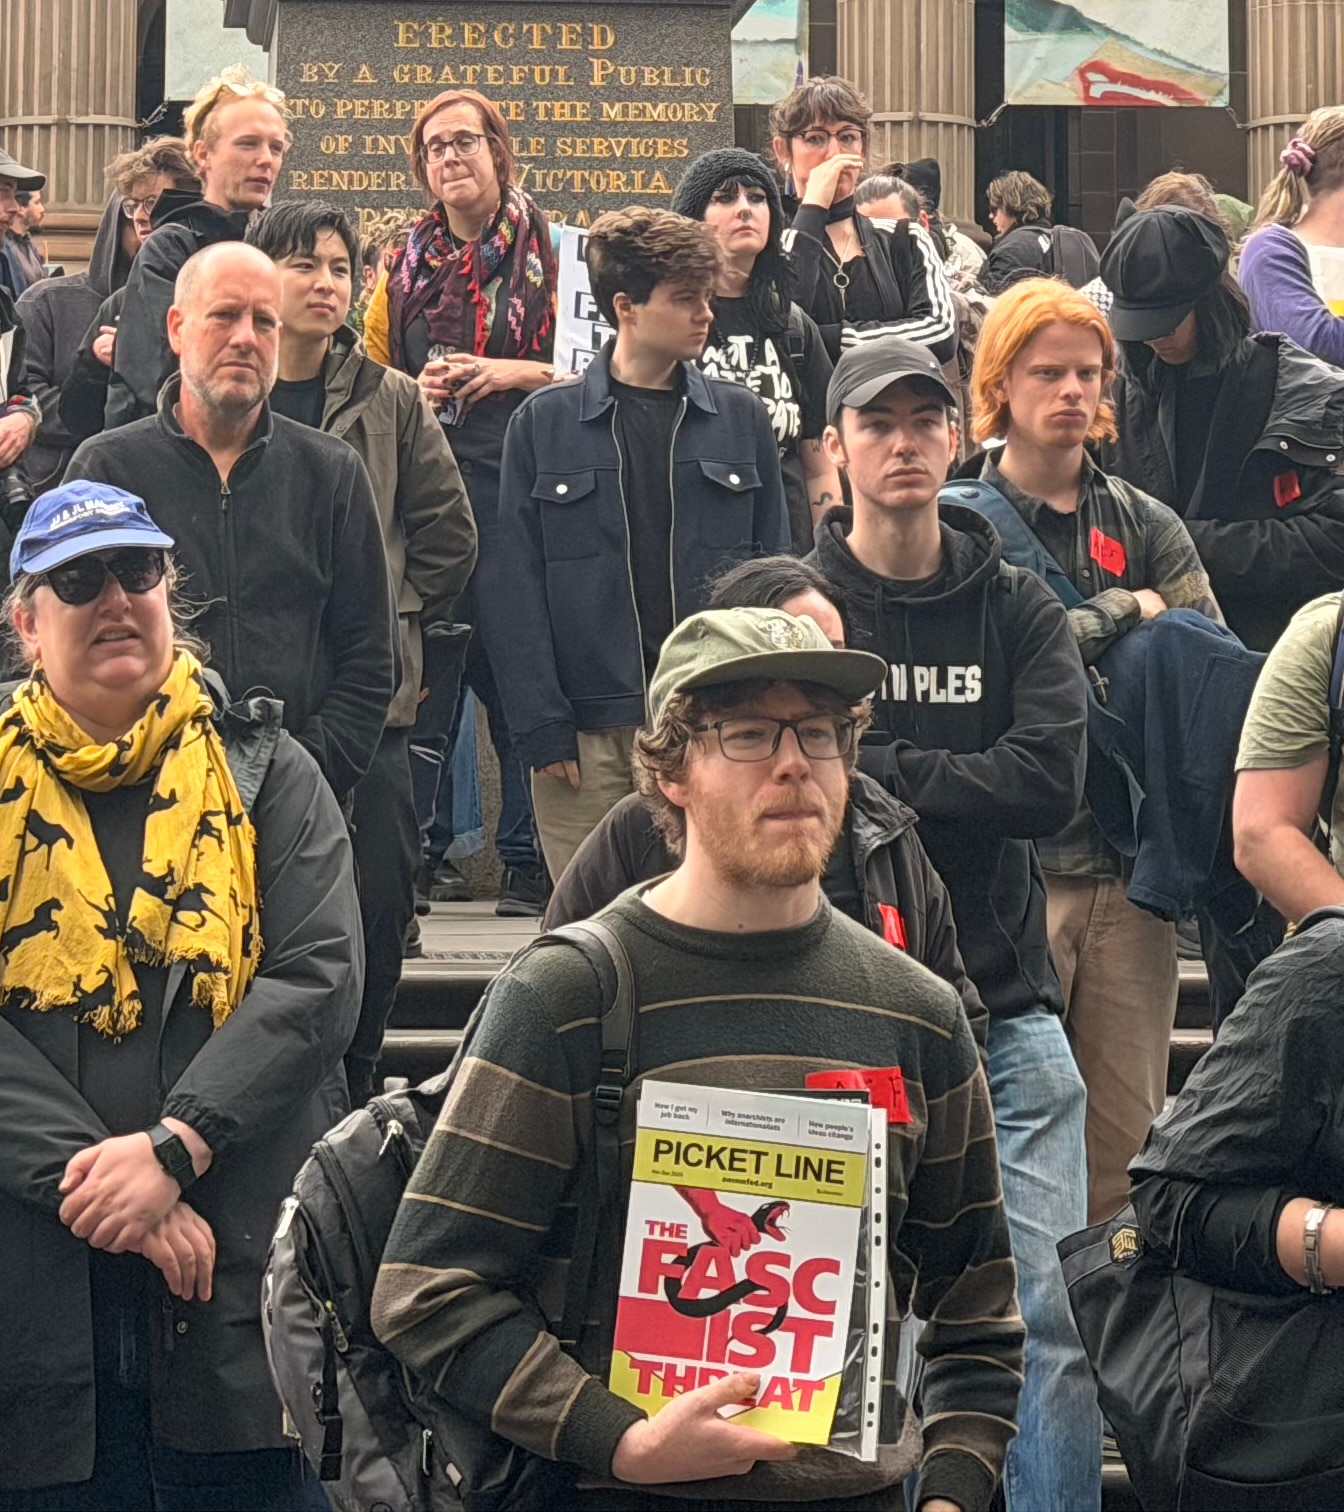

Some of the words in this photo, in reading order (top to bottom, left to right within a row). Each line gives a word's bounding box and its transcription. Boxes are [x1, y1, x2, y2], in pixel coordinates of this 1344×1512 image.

[393, 19, 617, 50] ERECTED
[299, 62, 344, 83] BY
[353, 62, 378, 83] A
[393, 64, 575, 85] GRATEFUL
[588, 57, 713, 86] PUBLIC
[289, 98, 325, 119] TO
[533, 100, 592, 121] THE
[600, 101, 719, 123] MEMORY
[320, 136, 352, 155] OF
[556, 136, 689, 158] SERVICES
[652, 1138, 770, 1175] PICKET
[775, 1153, 846, 1186] LINE
[644, 1219, 689, 1239] THE
[637, 1238, 842, 1316] FASC
[705, 1307, 835, 1375] IST
